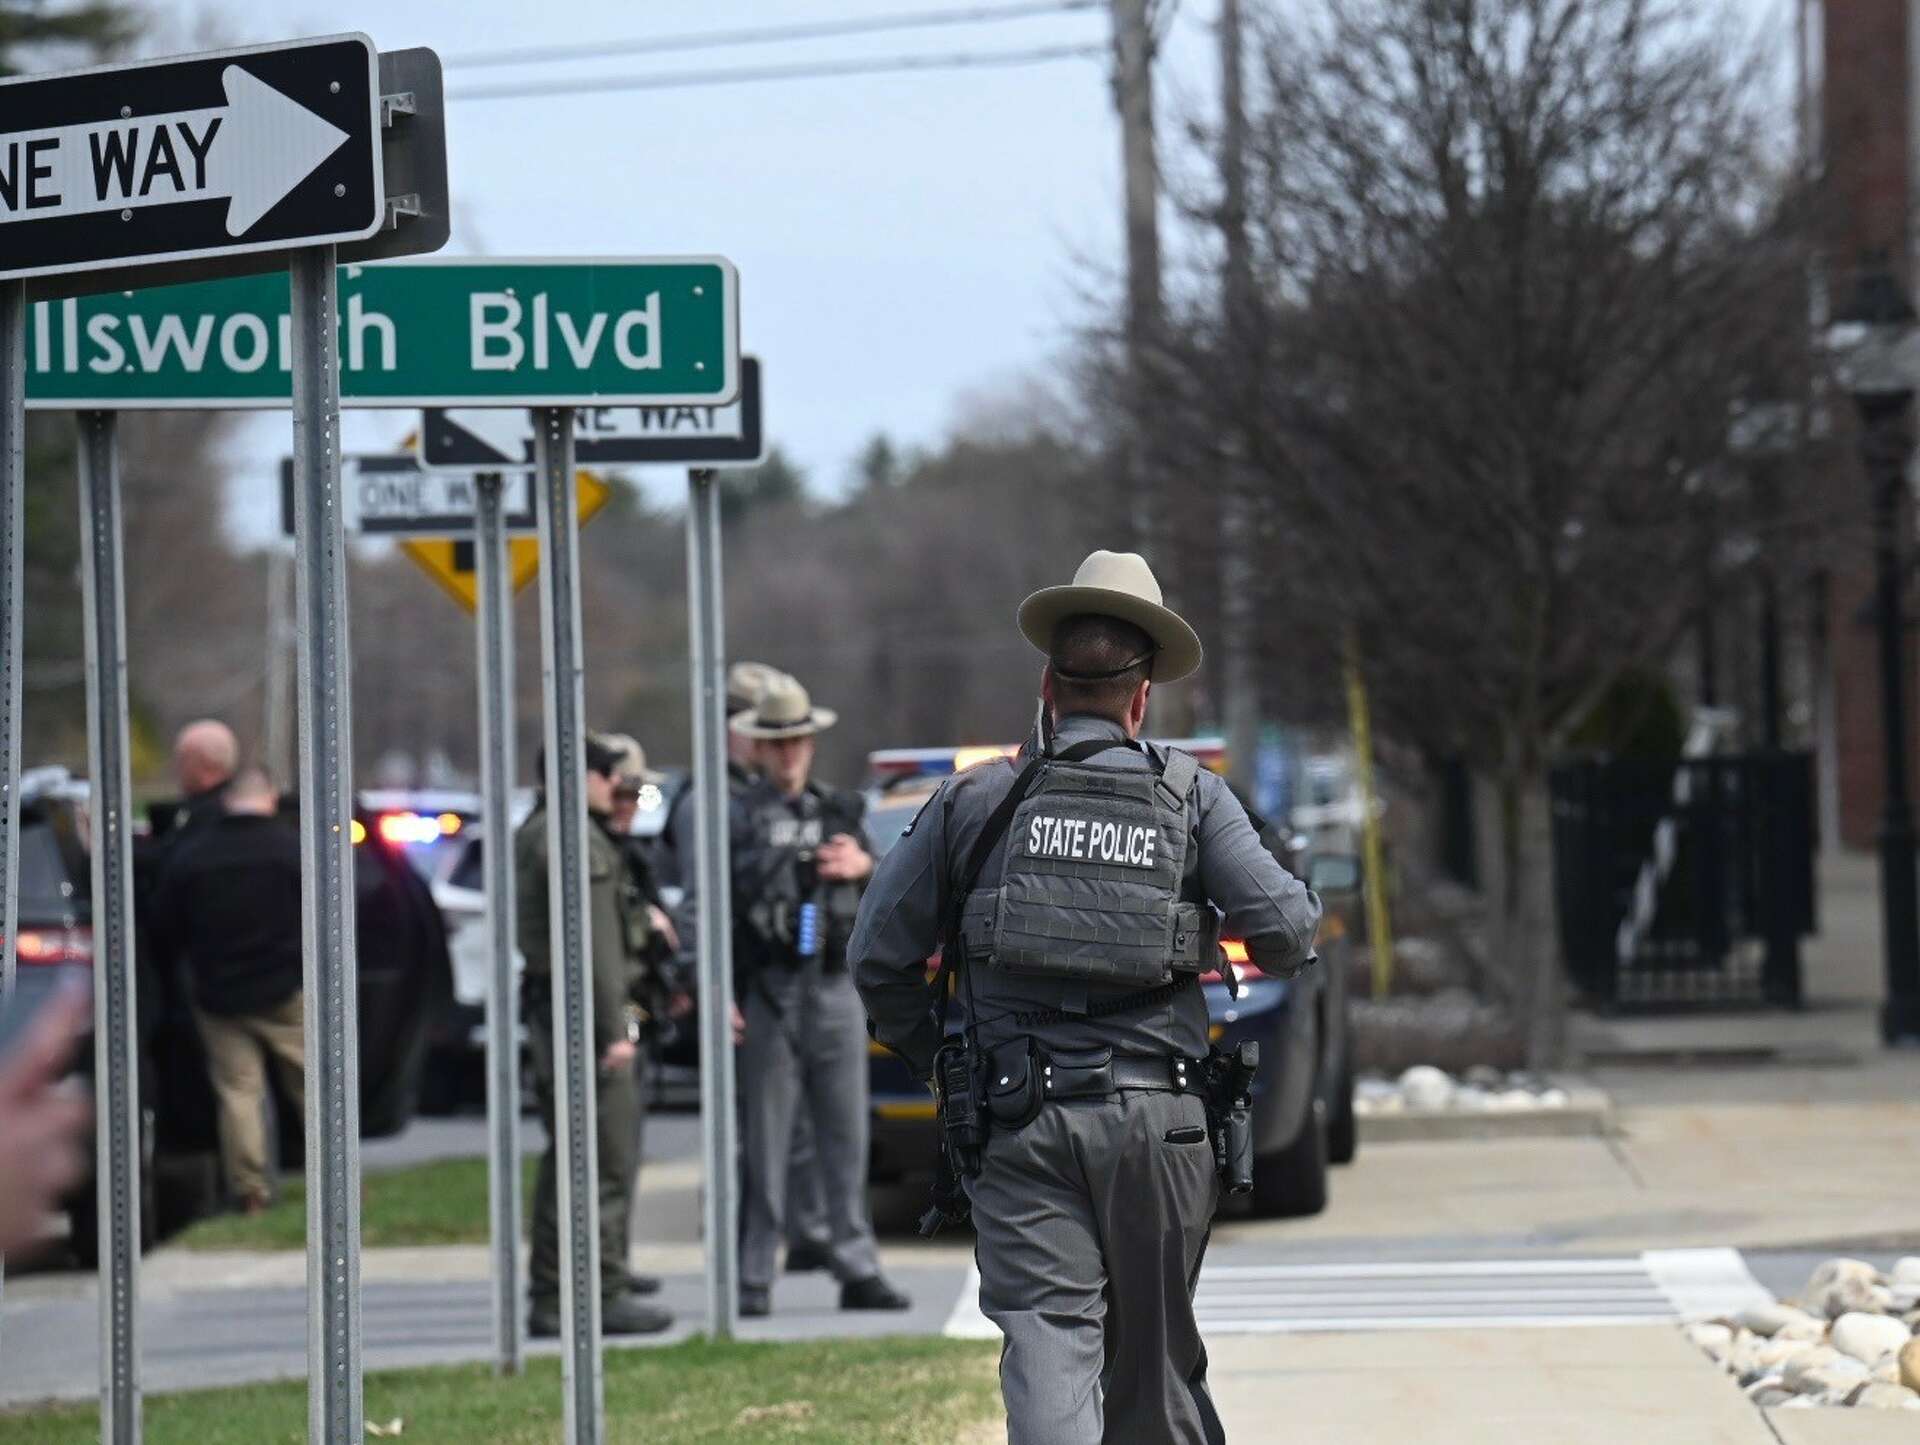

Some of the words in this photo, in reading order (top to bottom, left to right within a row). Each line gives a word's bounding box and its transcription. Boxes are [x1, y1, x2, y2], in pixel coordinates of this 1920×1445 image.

[88, 117, 223, 201] WAY
[469, 290, 662, 371] Blvd
[1029, 815, 1087, 858] STATE
[1087, 821, 1157, 866] POLICE
